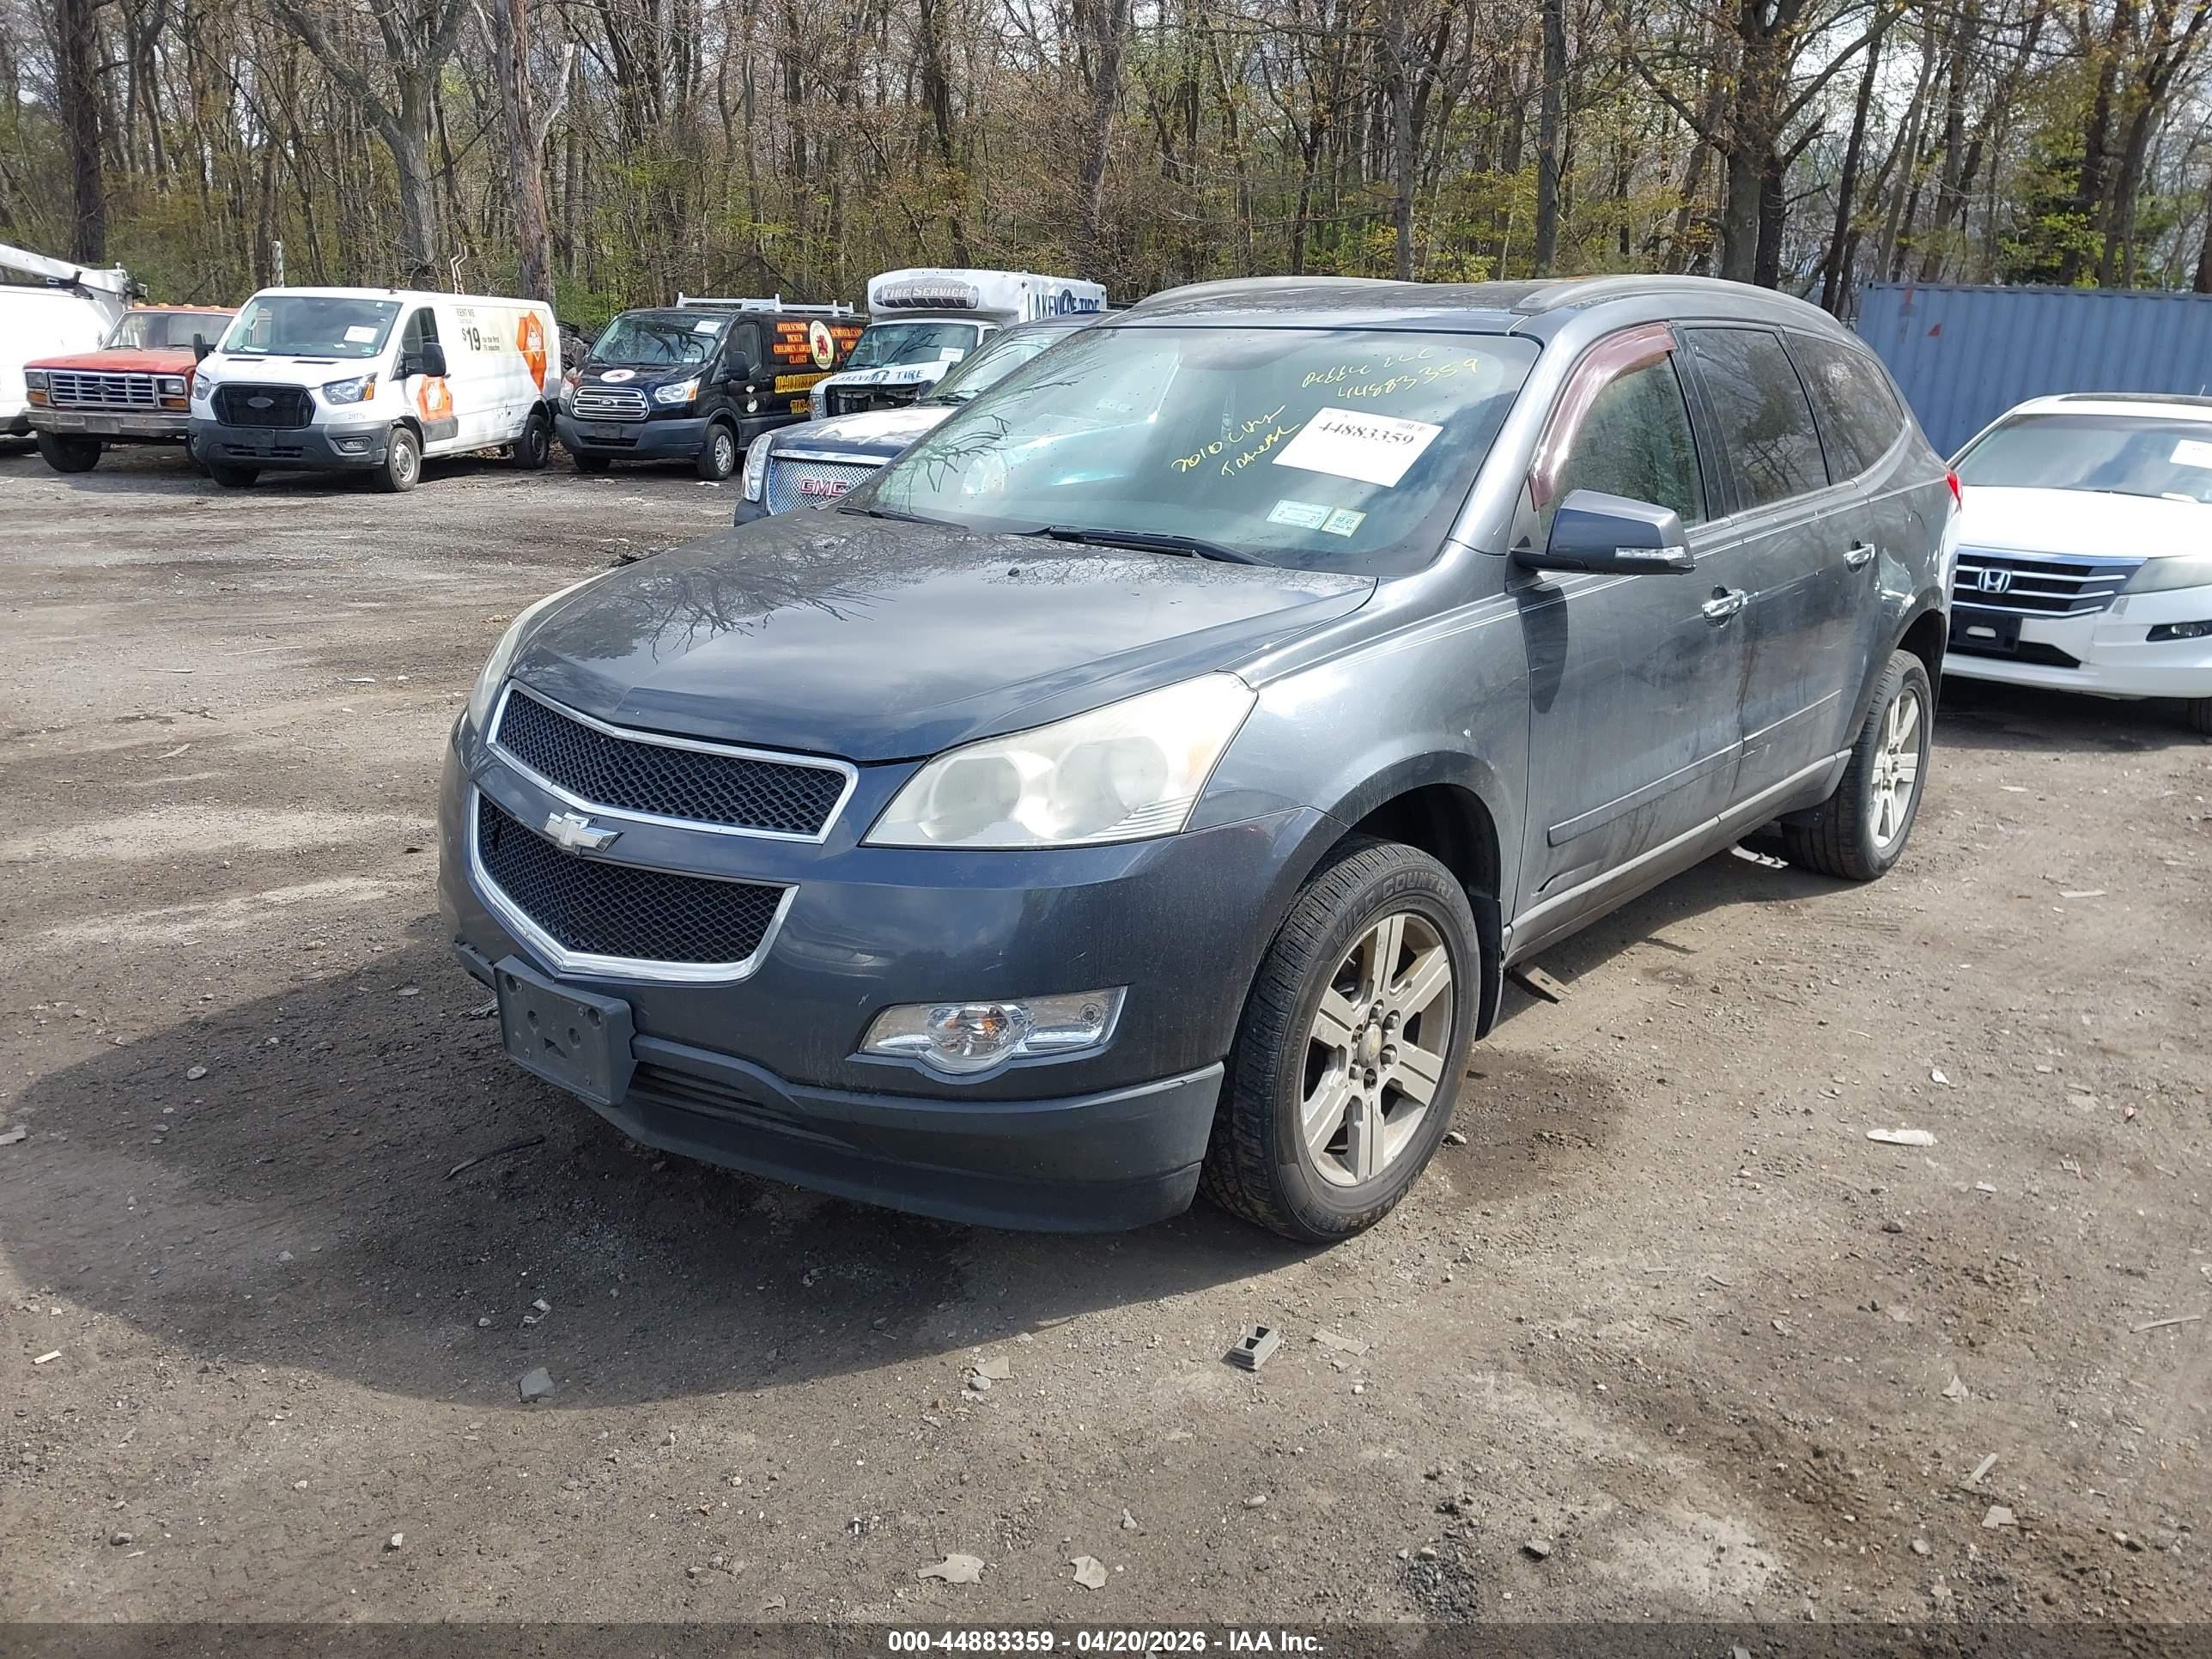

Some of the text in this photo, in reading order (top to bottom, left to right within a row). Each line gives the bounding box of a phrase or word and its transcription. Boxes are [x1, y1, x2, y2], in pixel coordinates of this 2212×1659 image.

[884, 286, 968, 298] TIRE SERVICE
[462, 327, 481, 351] $19
[896, 370, 926, 382] TIRE
[1338, 358, 1479, 398] 44883359
[1319, 422, 1414, 445] 44883359
[800, 478, 848, 497] GMC
[1382, 871, 1455, 900] COUNTRY
